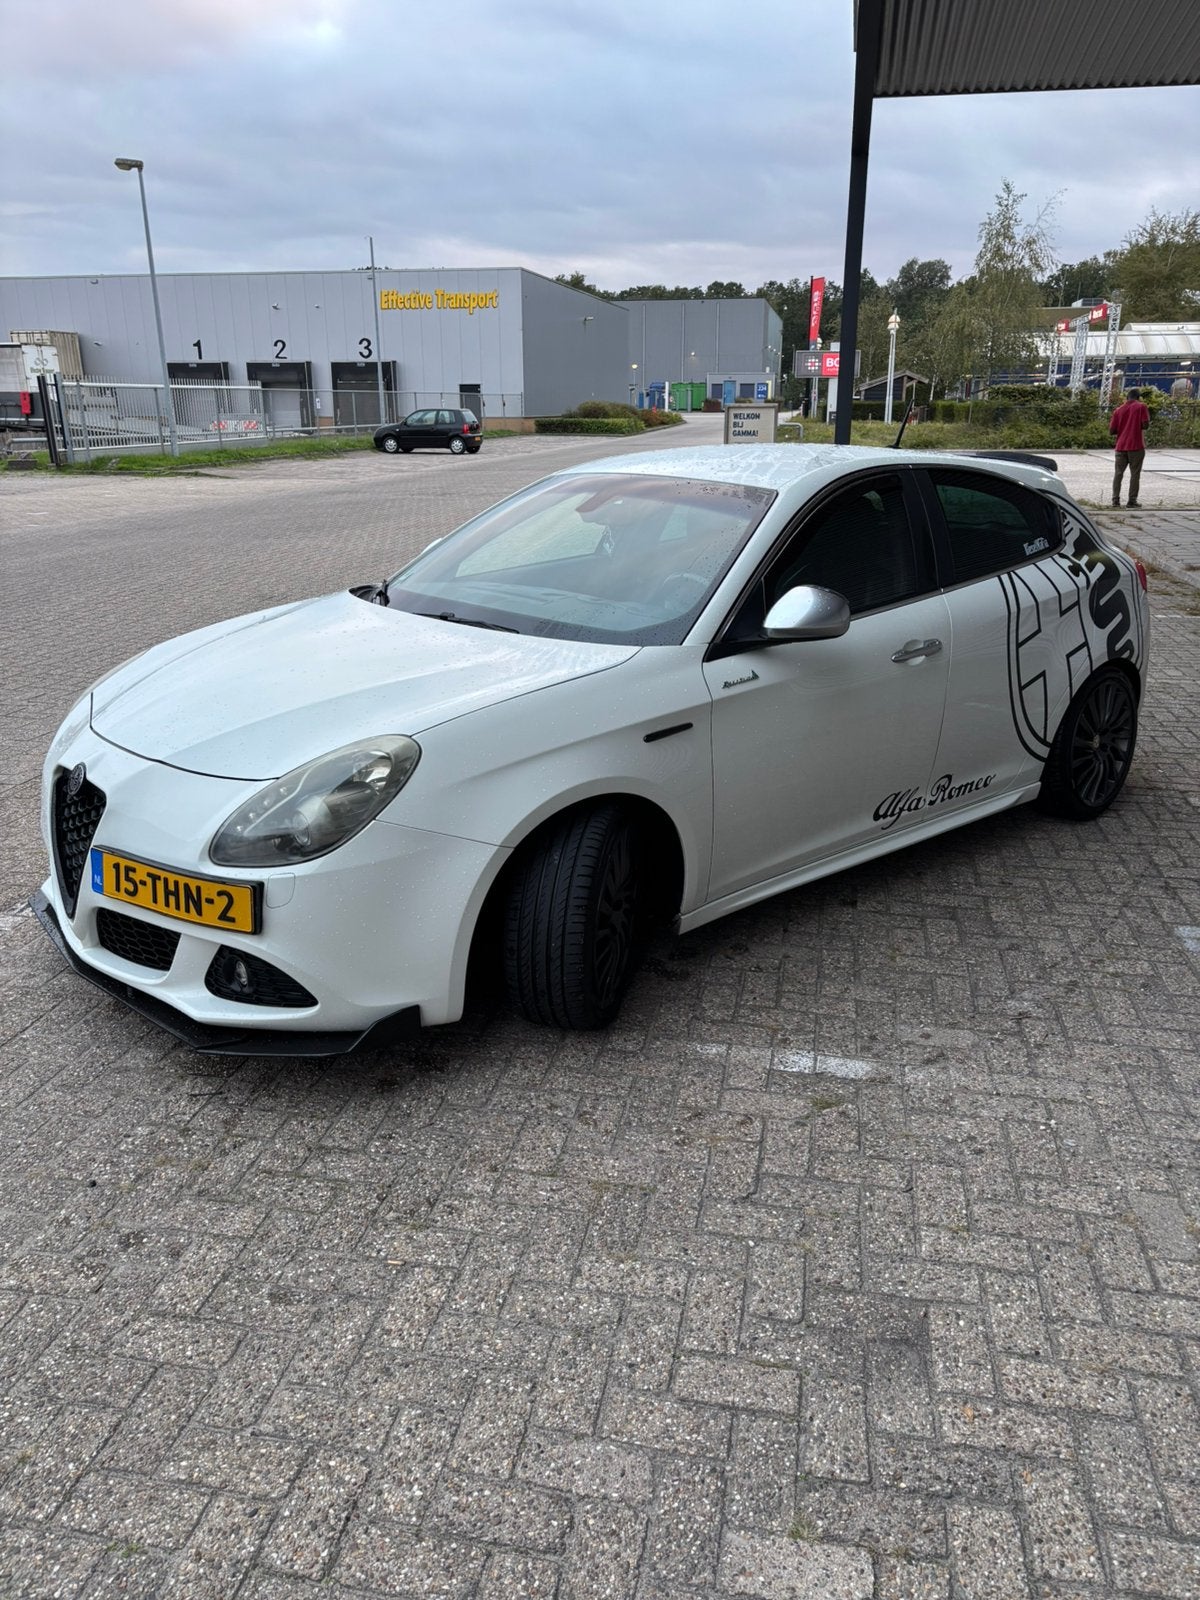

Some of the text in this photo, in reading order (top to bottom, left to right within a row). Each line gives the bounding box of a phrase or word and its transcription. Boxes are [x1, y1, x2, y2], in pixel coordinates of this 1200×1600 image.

[381, 288, 498, 315] Effective Transport
[193, 339, 203, 360] 1
[273, 339, 288, 360] 2
[358, 337, 373, 359] 3
[732, 412, 761, 420] WELKOM
[873, 774, 997, 830] Alfa Romeo
[94, 873, 103, 886] NL
[112, 861, 236, 924] 15-THN-2
